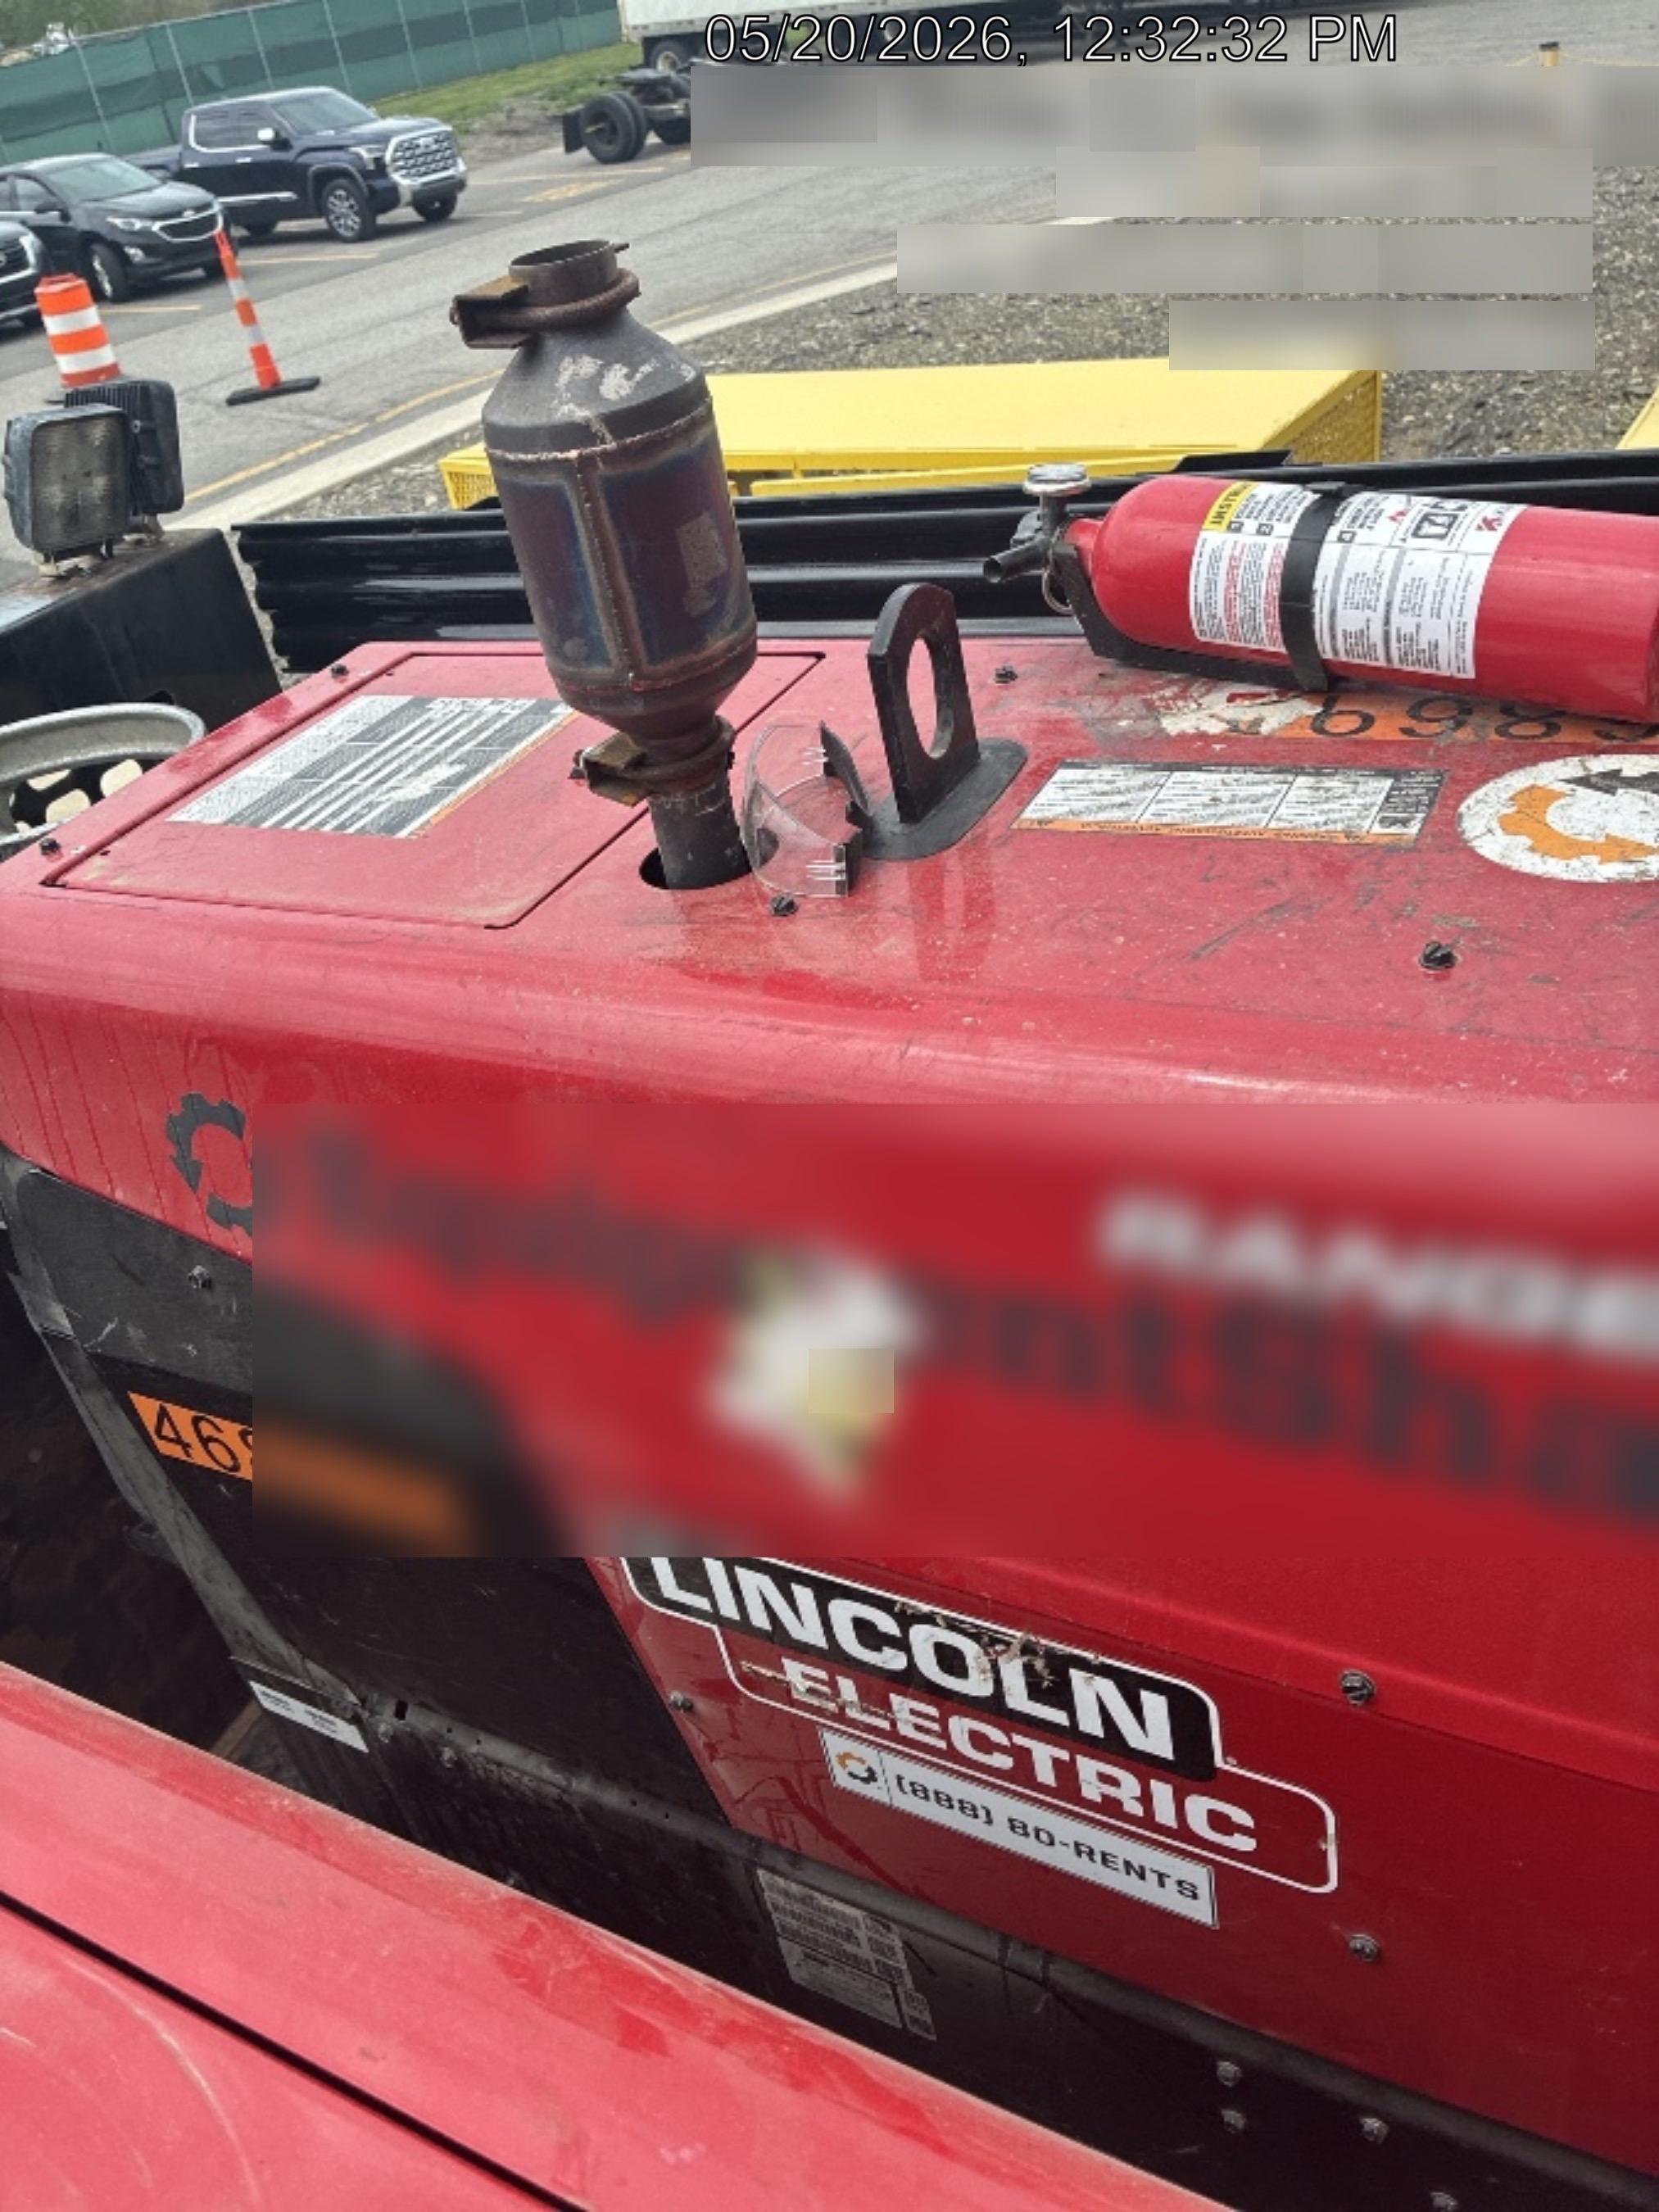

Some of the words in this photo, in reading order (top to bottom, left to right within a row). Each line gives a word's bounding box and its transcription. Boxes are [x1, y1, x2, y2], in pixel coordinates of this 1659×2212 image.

[650, 1557, 1175, 1761] LINCOLN
[782, 1657, 1258, 1852] ELECTRIC
[895, 1773, 995, 1826] (888)
[1007, 1815, 1201, 1902] 80-RENTS
